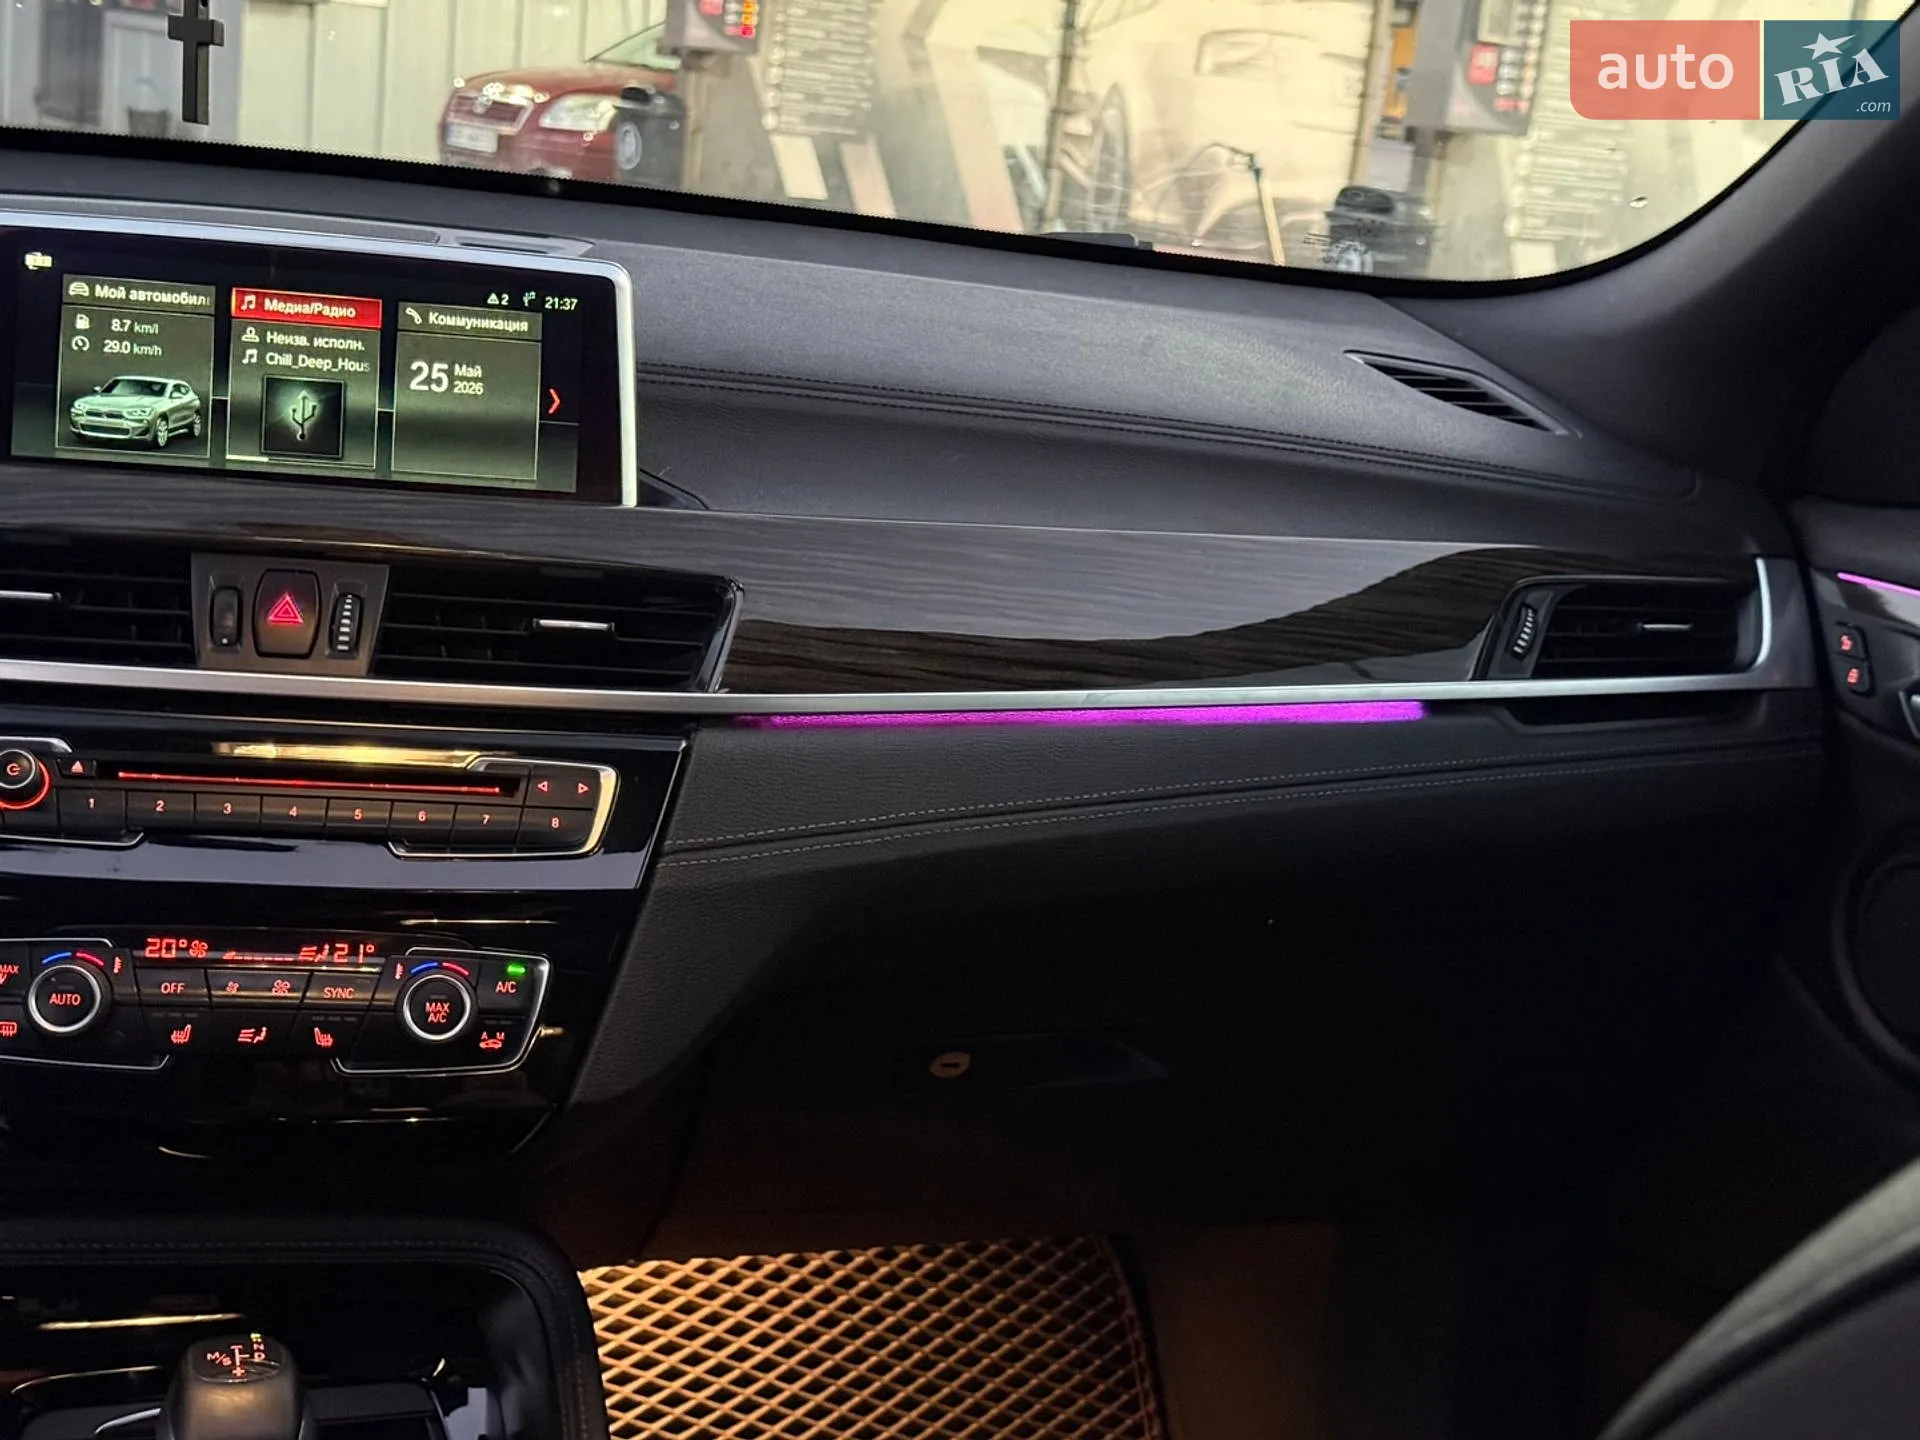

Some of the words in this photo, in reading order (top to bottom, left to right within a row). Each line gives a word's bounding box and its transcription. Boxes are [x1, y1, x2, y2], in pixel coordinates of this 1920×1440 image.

[94, 284, 126, 300] Мой
[501, 293, 510, 306] 2
[544, 296, 578, 311] 21:37
[264, 297, 356, 318] Медиа/Радио
[111, 319, 132, 332] 8.7
[134, 321, 159, 334] km/l
[428, 311, 529, 332] Коммуникация
[266, 330, 310, 347] Неизв.
[313, 336, 365, 351] исполн.
[103, 339, 131, 354] 29.0
[132, 342, 163, 356] km/h
[265, 351, 371, 373] Chill_Deep_Hous
[409, 361, 449, 392] 25
[454, 363, 482, 378] Май
[453, 381, 484, 395] 2026
[88, 798, 95, 808] 1
[155, 800, 165, 812] 2
[223, 803, 232, 815] 3
[288, 806, 298, 818] 4
[353, 808, 363, 820] 5
[417, 812, 427, 822] 6
[481, 814, 490, 825] 7
[551, 817, 560, 828] 8
[160, 982, 185, 994] OFF
[323, 987, 354, 999] SYNC
[495, 981, 517, 994] A/C
[49, 993, 81, 1006] AUTO
[425, 1002, 450, 1013] MAX
[427, 1013, 447, 1024] A/C
[481, 1031, 488, 1040] A
[496, 1031, 505, 1040] M
[206, 1351, 233, 1367] M/S
[254, 1352, 266, 1361] D
